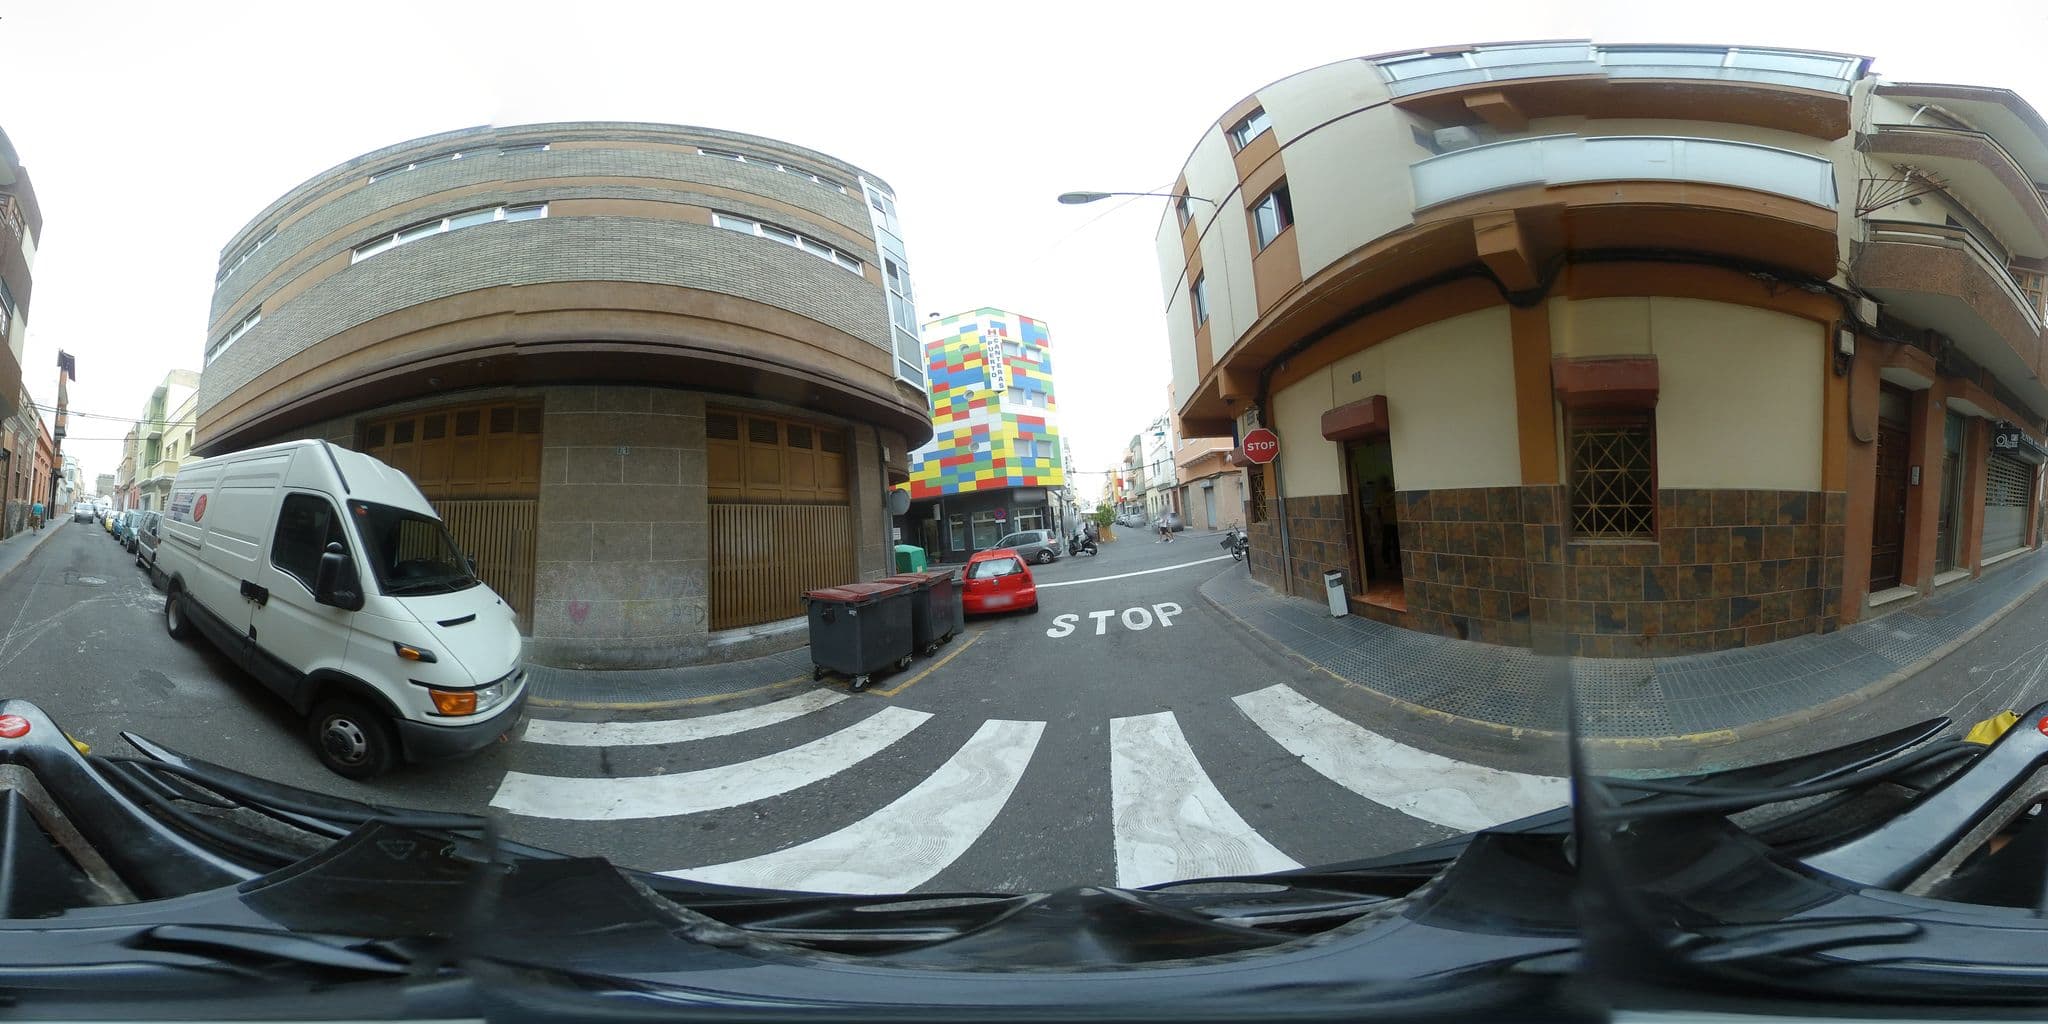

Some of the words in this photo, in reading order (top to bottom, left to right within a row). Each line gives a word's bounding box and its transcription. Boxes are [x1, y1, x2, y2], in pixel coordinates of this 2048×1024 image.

[987, 340, 997, 378] PUERTO
[993, 338, 1005, 389] CANTERAS
[1247, 441, 1275, 451] STOP
[1046, 602, 1183, 638] STOP
